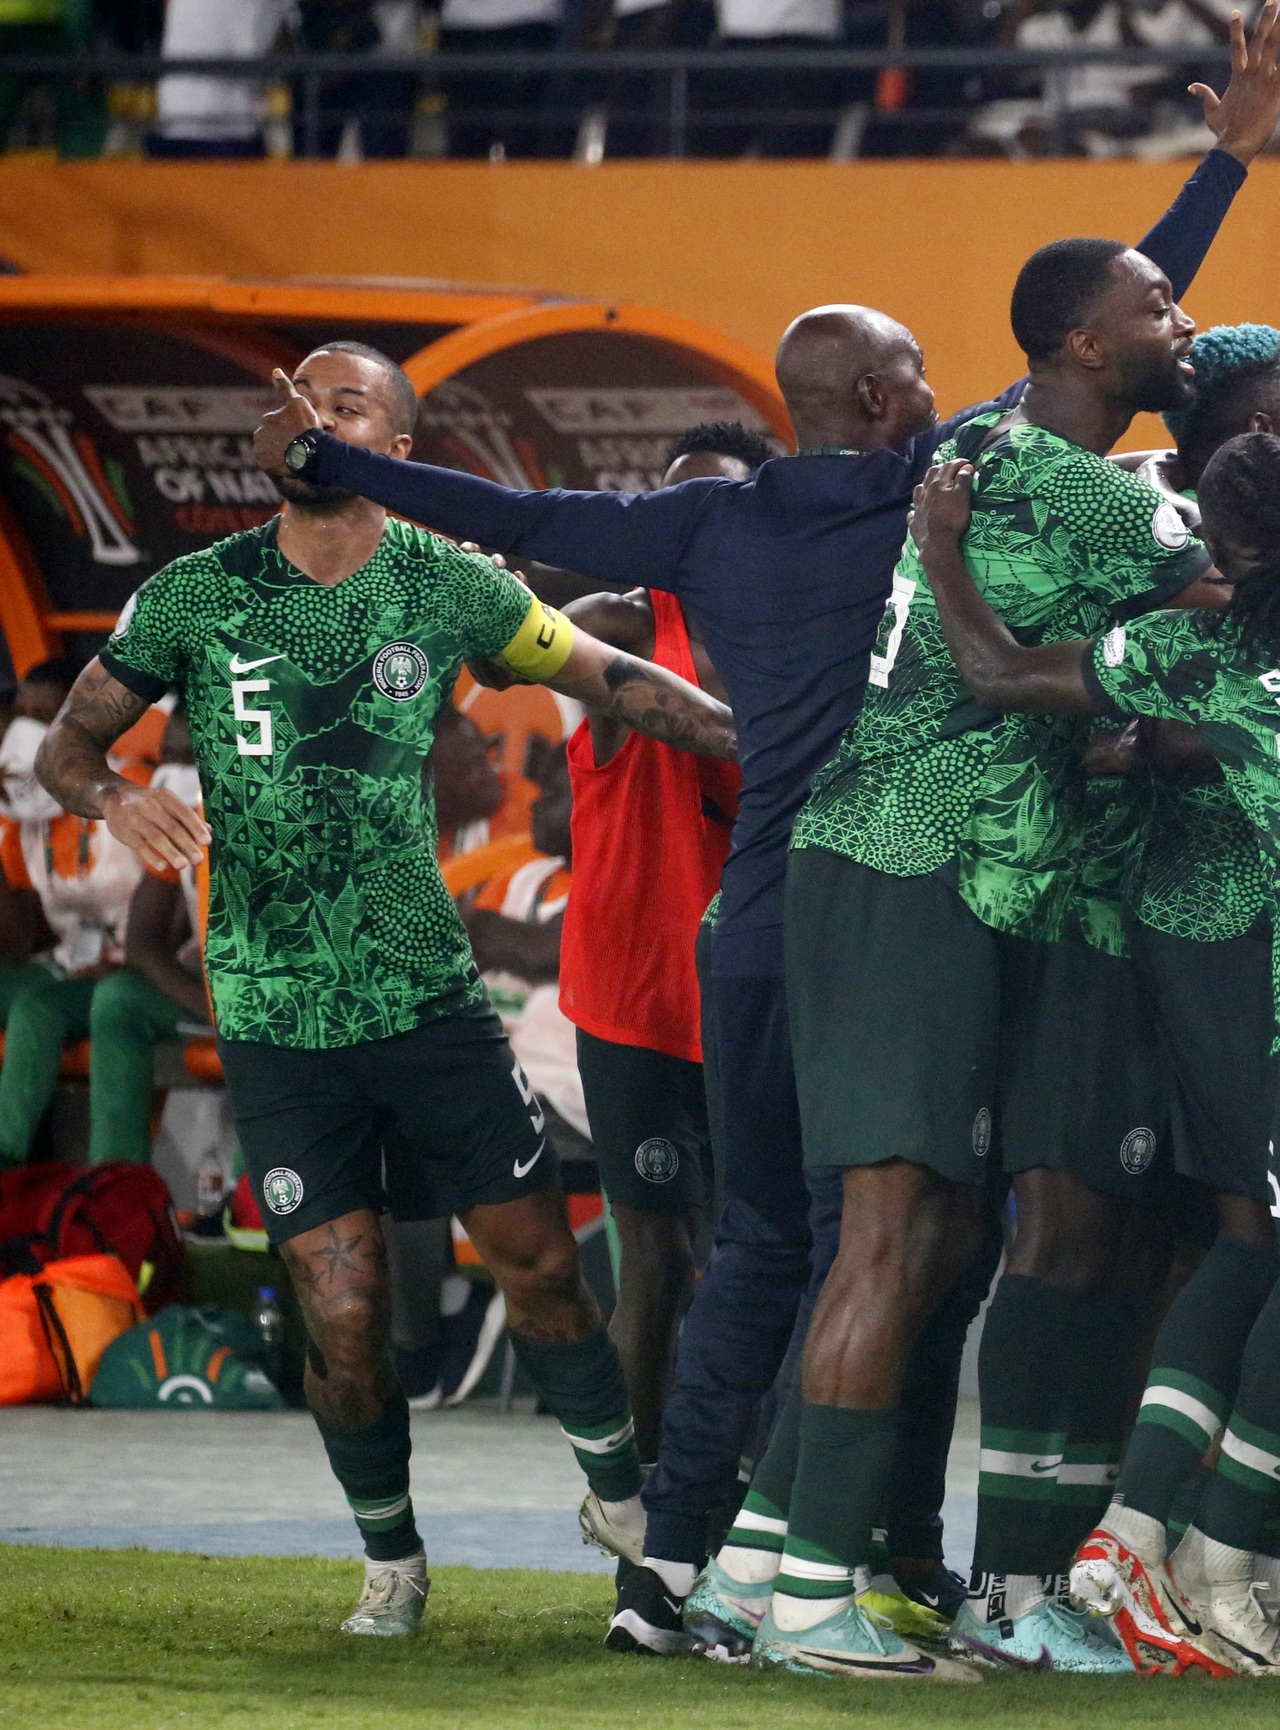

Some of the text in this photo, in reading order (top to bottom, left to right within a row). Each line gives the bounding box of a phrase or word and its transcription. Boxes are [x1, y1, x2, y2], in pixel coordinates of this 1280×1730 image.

[380, 645, 412, 662] FOOTBALL
[411, 649, 426, 690] FEDERATION
[231, 679, 273, 756] 5
